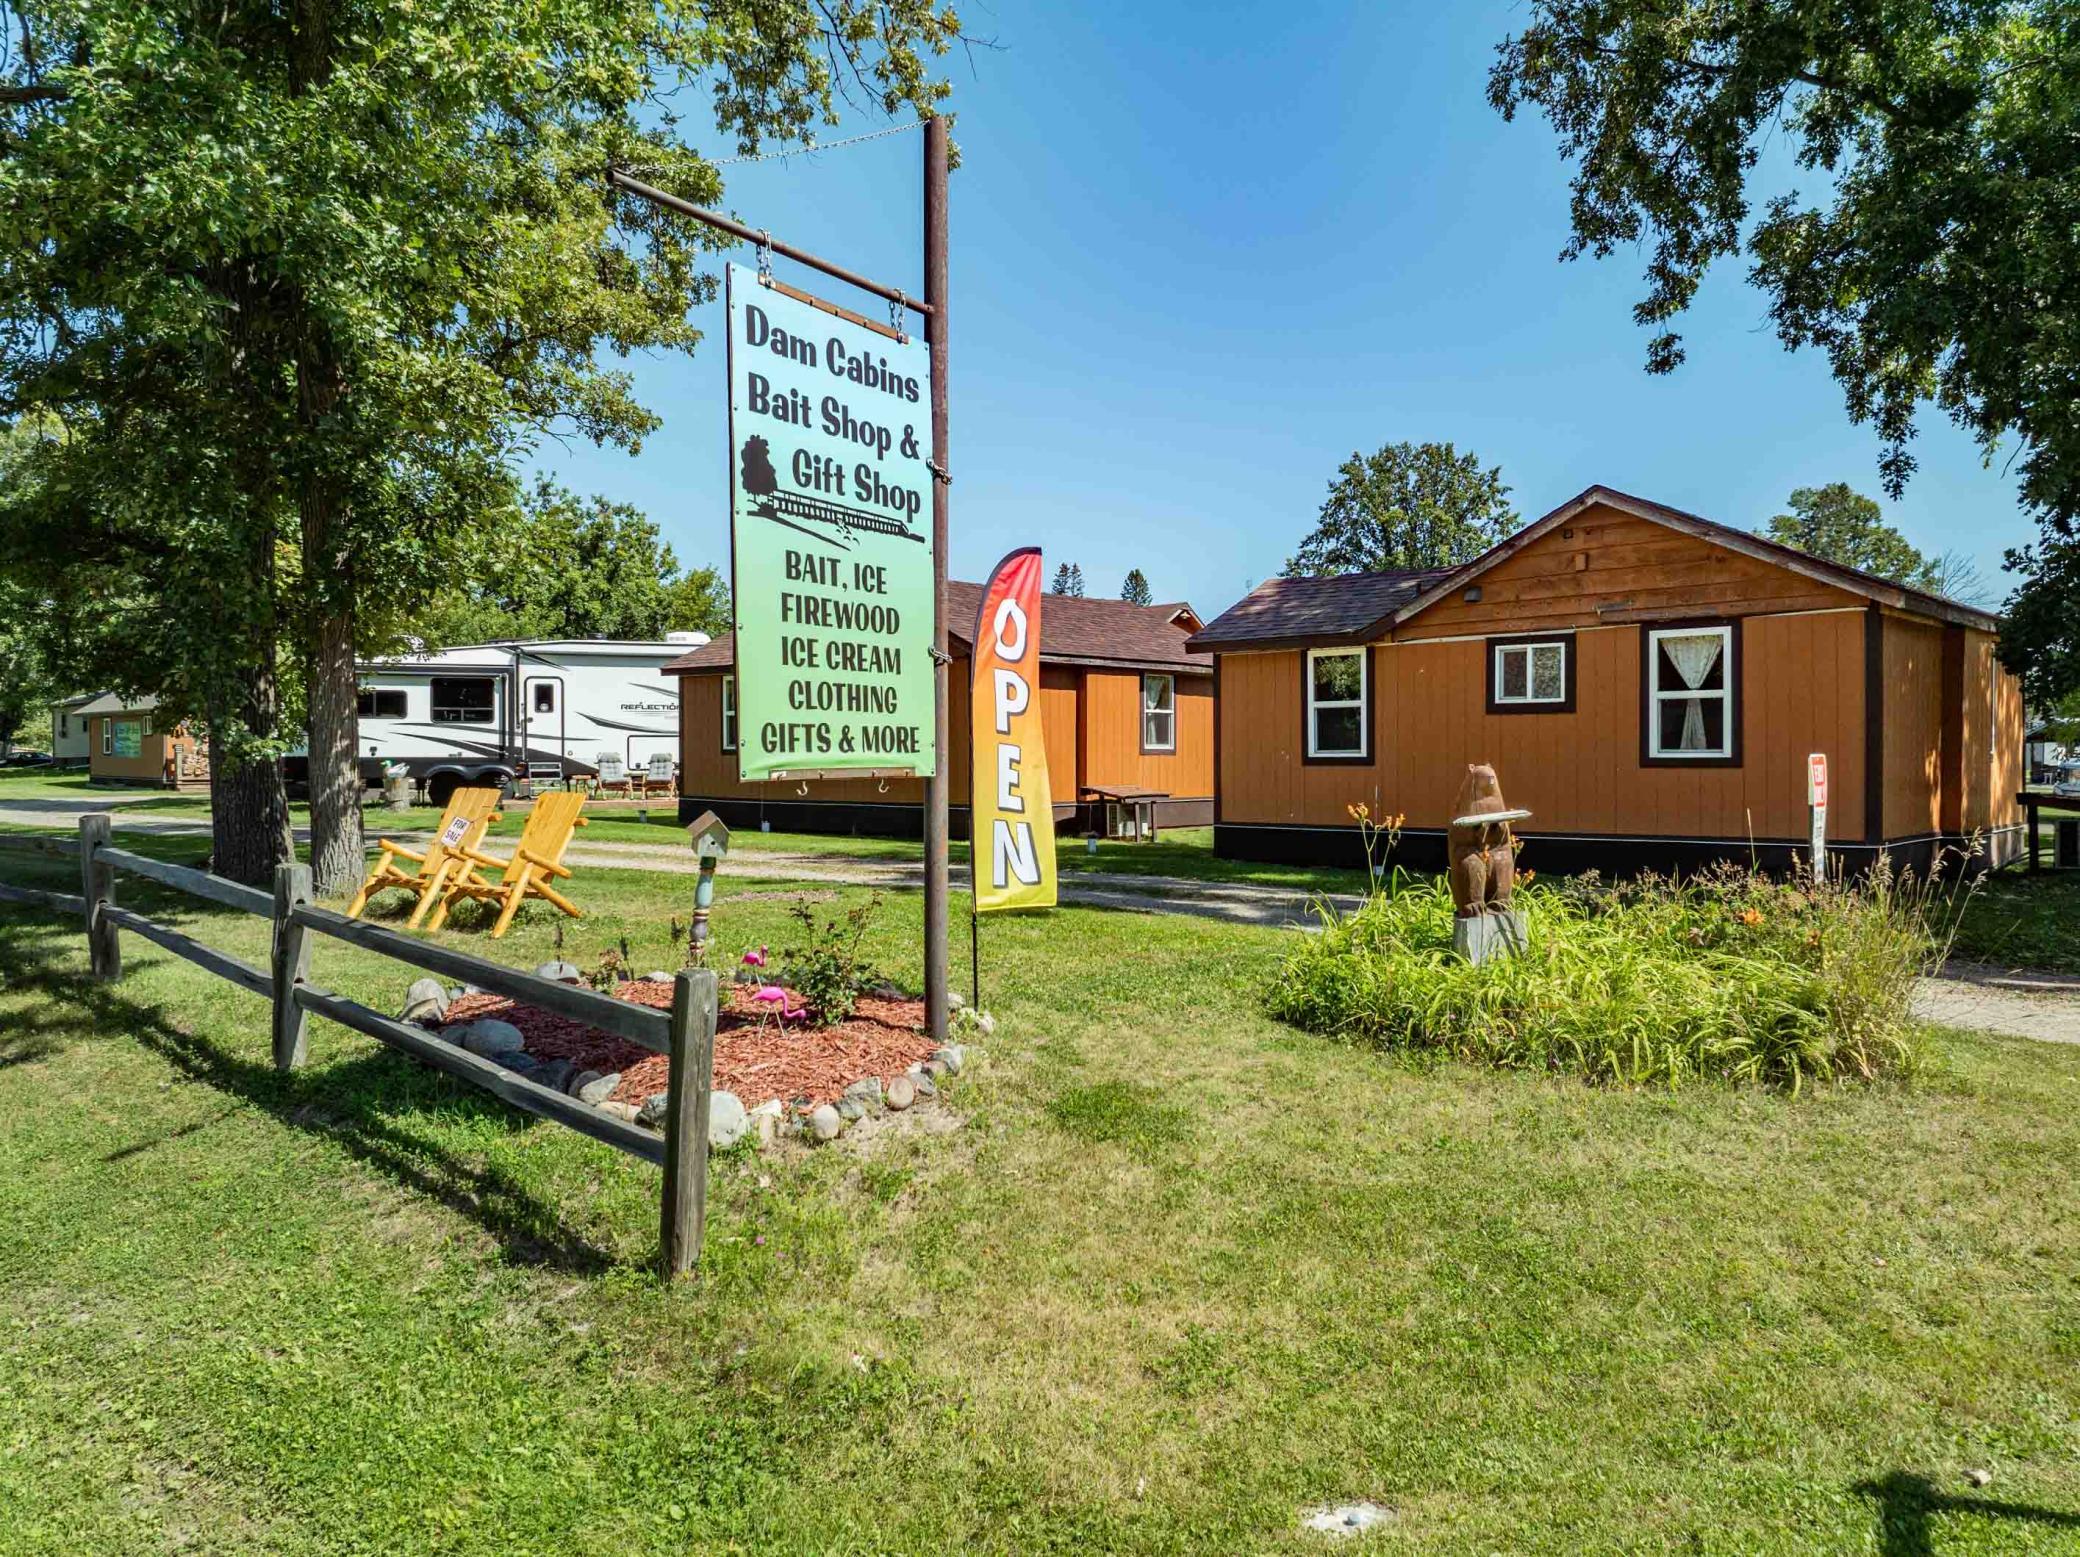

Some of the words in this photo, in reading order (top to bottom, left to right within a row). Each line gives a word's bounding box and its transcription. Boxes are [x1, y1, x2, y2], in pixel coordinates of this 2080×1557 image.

[745, 304, 817, 368] Dam
[826, 337, 919, 403] Cabins
[748, 371, 812, 428] Bait
[821, 395, 891, 461] Shop
[900, 424, 920, 460] &
[792, 448, 846, 496] Gift
[854, 463, 921, 524] Shop
[785, 550, 848, 592] BAIT,
[854, 562, 888, 595] ICE
[781, 592, 900, 635] FIREWOOD
[781, 636, 820, 668] ICE
[825, 641, 902, 675] CREAM
[788, 680, 898, 714] CLOTHING
[761, 722, 832, 754] GIFTS
[838, 724, 856, 753] &
[861, 725, 921, 754] MORE
[992, 598, 1042, 889] OPEN
[445, 830, 461, 842] SALE
[453, 819, 467, 830] FOR
